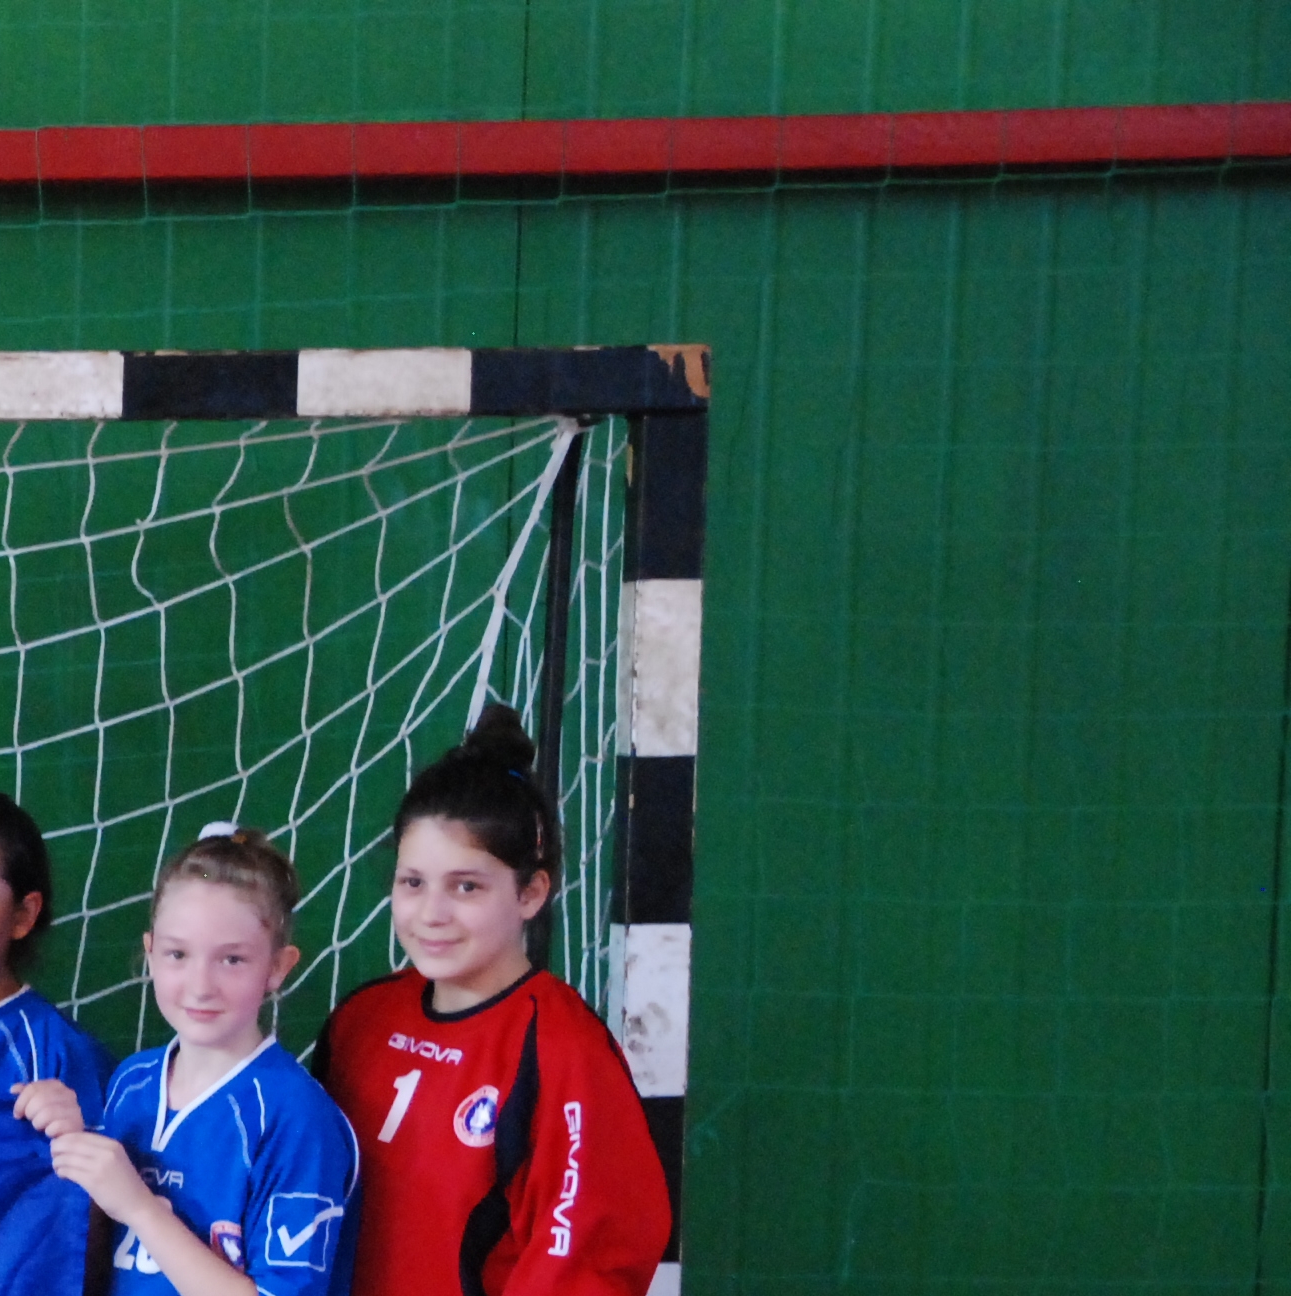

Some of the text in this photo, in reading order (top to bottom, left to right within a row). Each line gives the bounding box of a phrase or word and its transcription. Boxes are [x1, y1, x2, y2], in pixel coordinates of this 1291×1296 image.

[387, 1031, 463, 1065] GIVOVA
[377, 1069, 422, 1143] 1
[547, 1101, 582, 1257] GIVOVA
